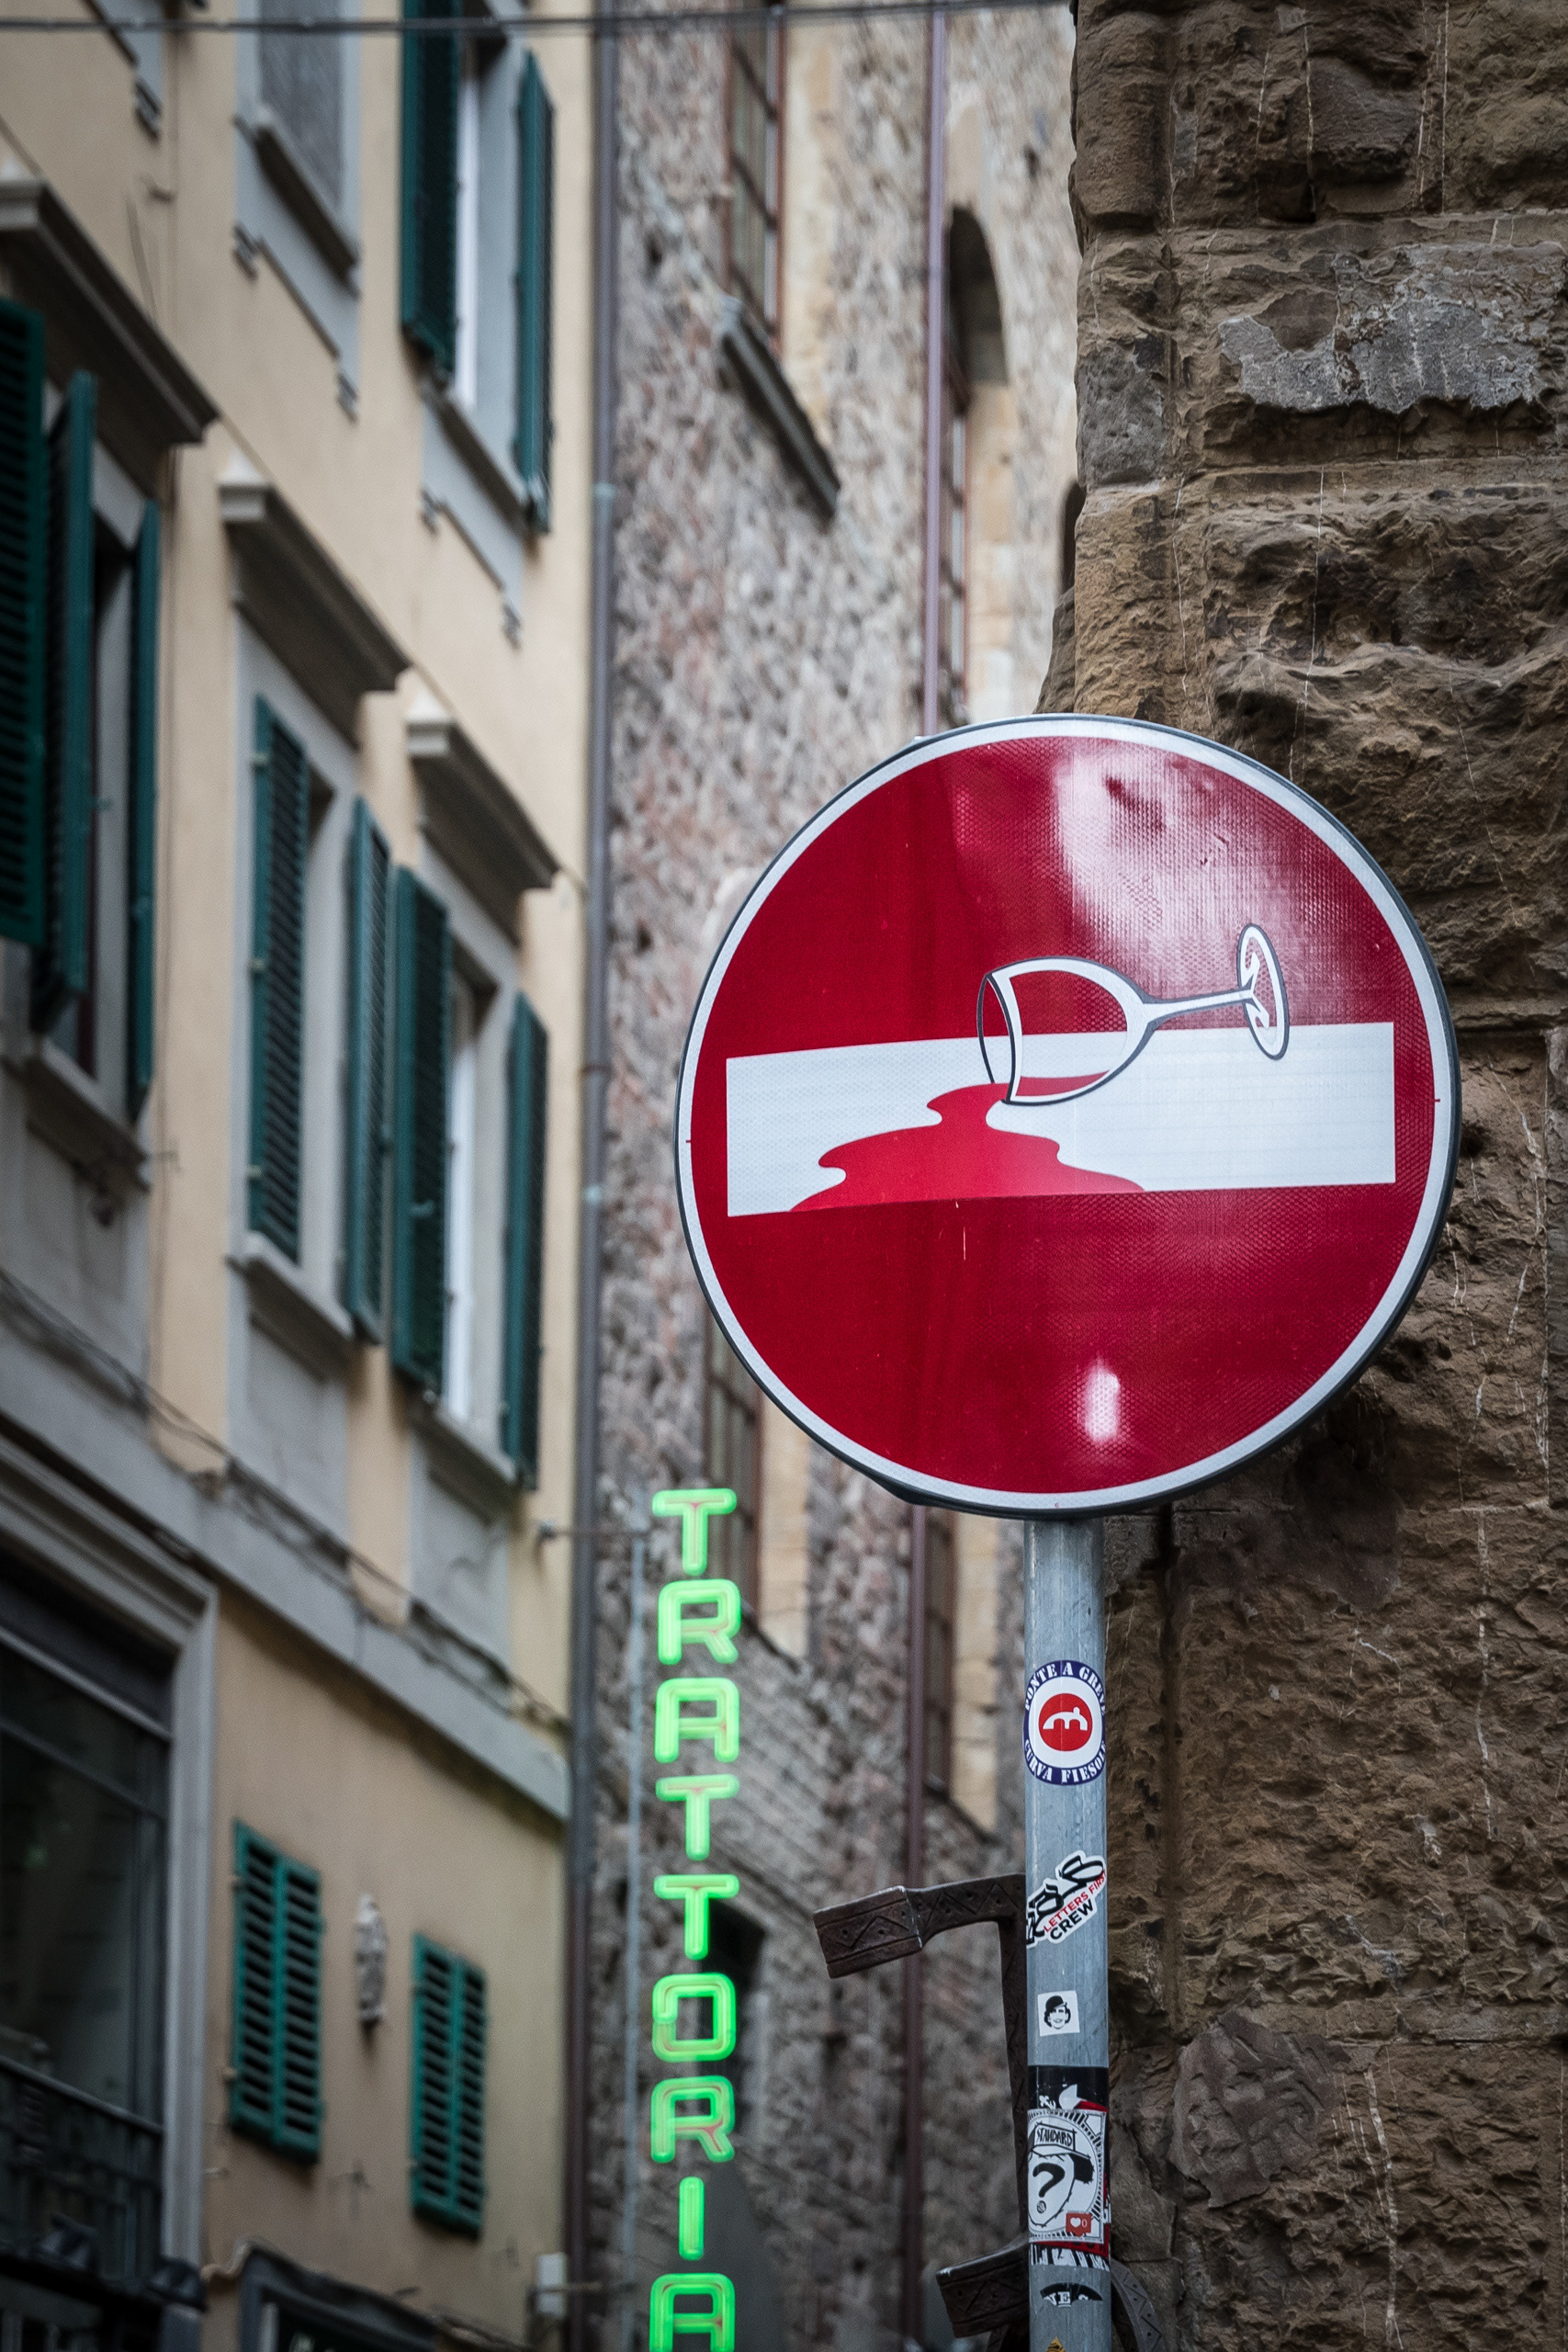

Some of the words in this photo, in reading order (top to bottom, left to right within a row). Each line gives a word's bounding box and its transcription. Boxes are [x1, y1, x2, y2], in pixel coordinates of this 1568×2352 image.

[1025, 1664, 1057, 1711] PONTE
[1062, 1662, 1074, 1676] A
[1078, 1667, 1106, 1715] GREVE
[1024, 1739, 1053, 1781] CURVA
[1061, 1740, 1106, 1783] FIESOLE
[650, 1488, 740, 2352] TRATTORIA
[1043, 1892, 1089, 1932] LETTERS
[1088, 1870, 1107, 1894] FIRST
[1050, 1899, 1093, 1939] CREW
